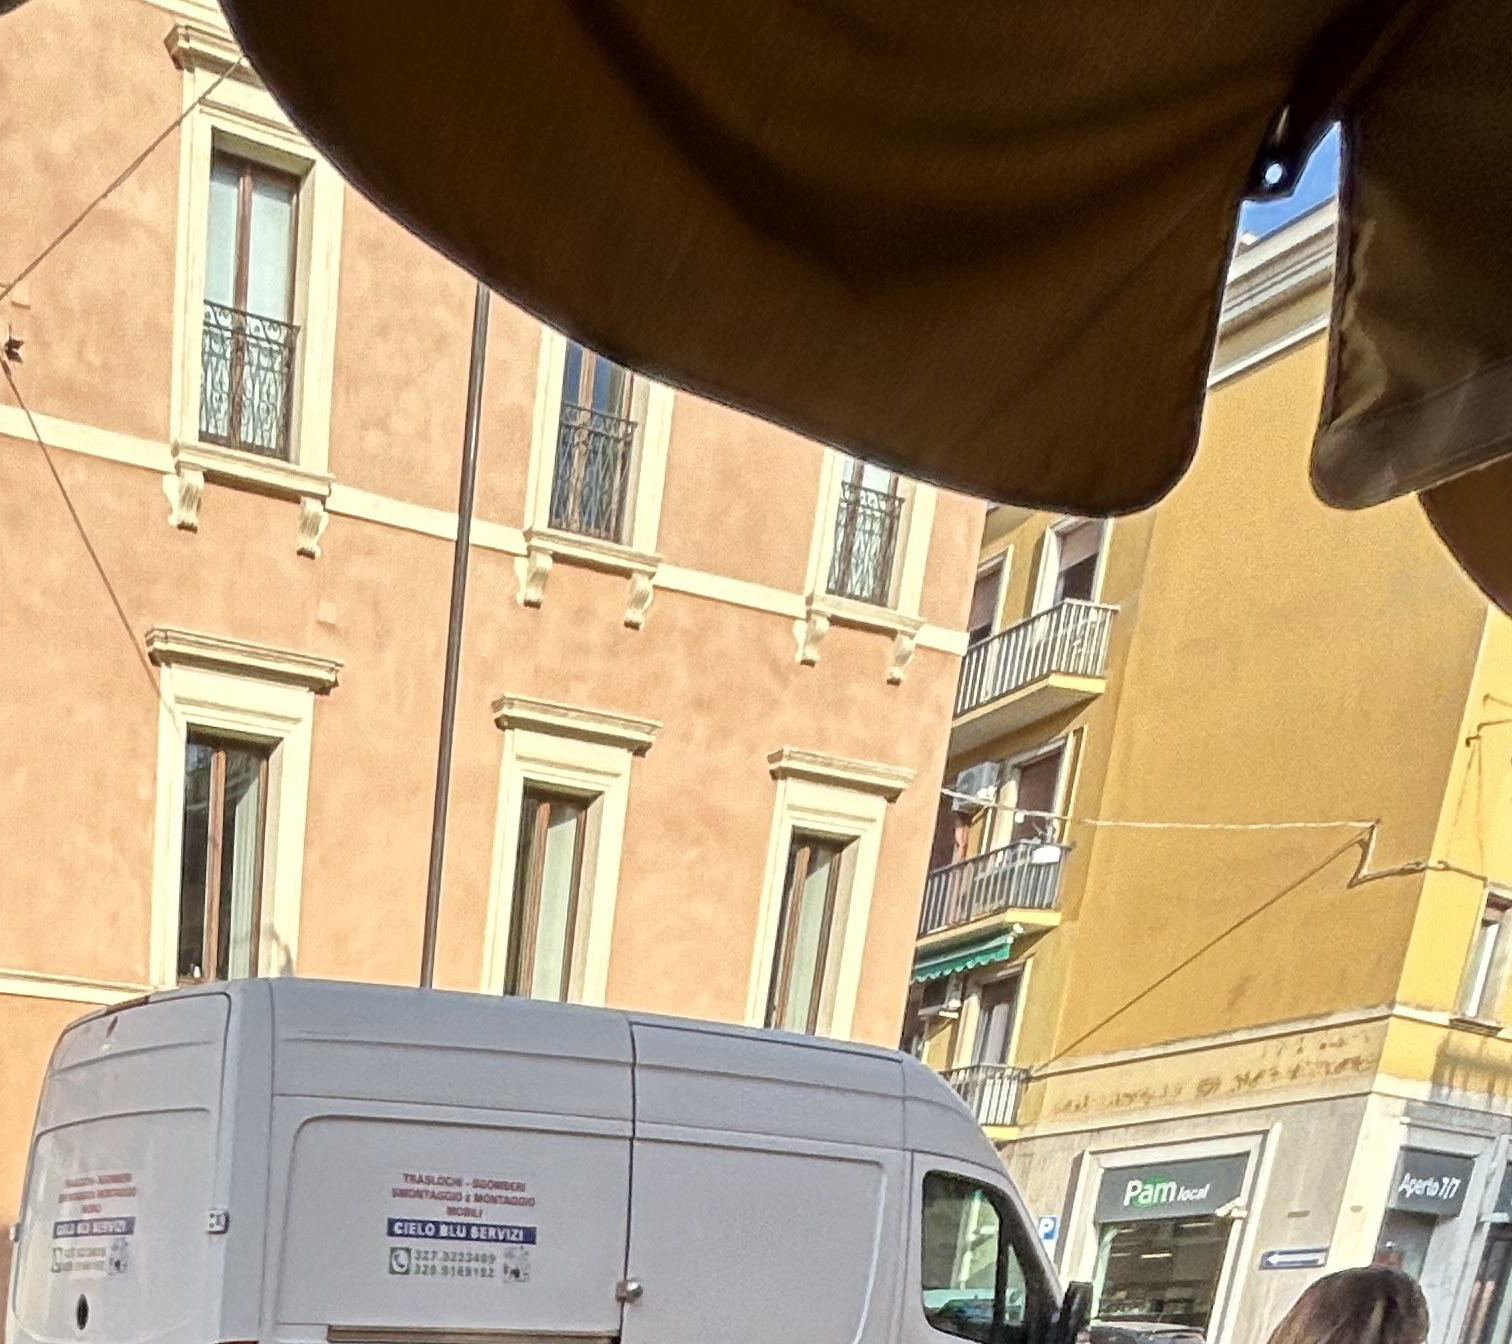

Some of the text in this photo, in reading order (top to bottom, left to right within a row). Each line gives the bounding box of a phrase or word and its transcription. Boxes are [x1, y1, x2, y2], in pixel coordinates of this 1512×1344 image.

[1123, 1179, 1210, 1206] Pam local
[1398, 1172, 1439, 1198] Aperto
[393, 1222, 524, 1241] CIELO BLU SERVIZI
